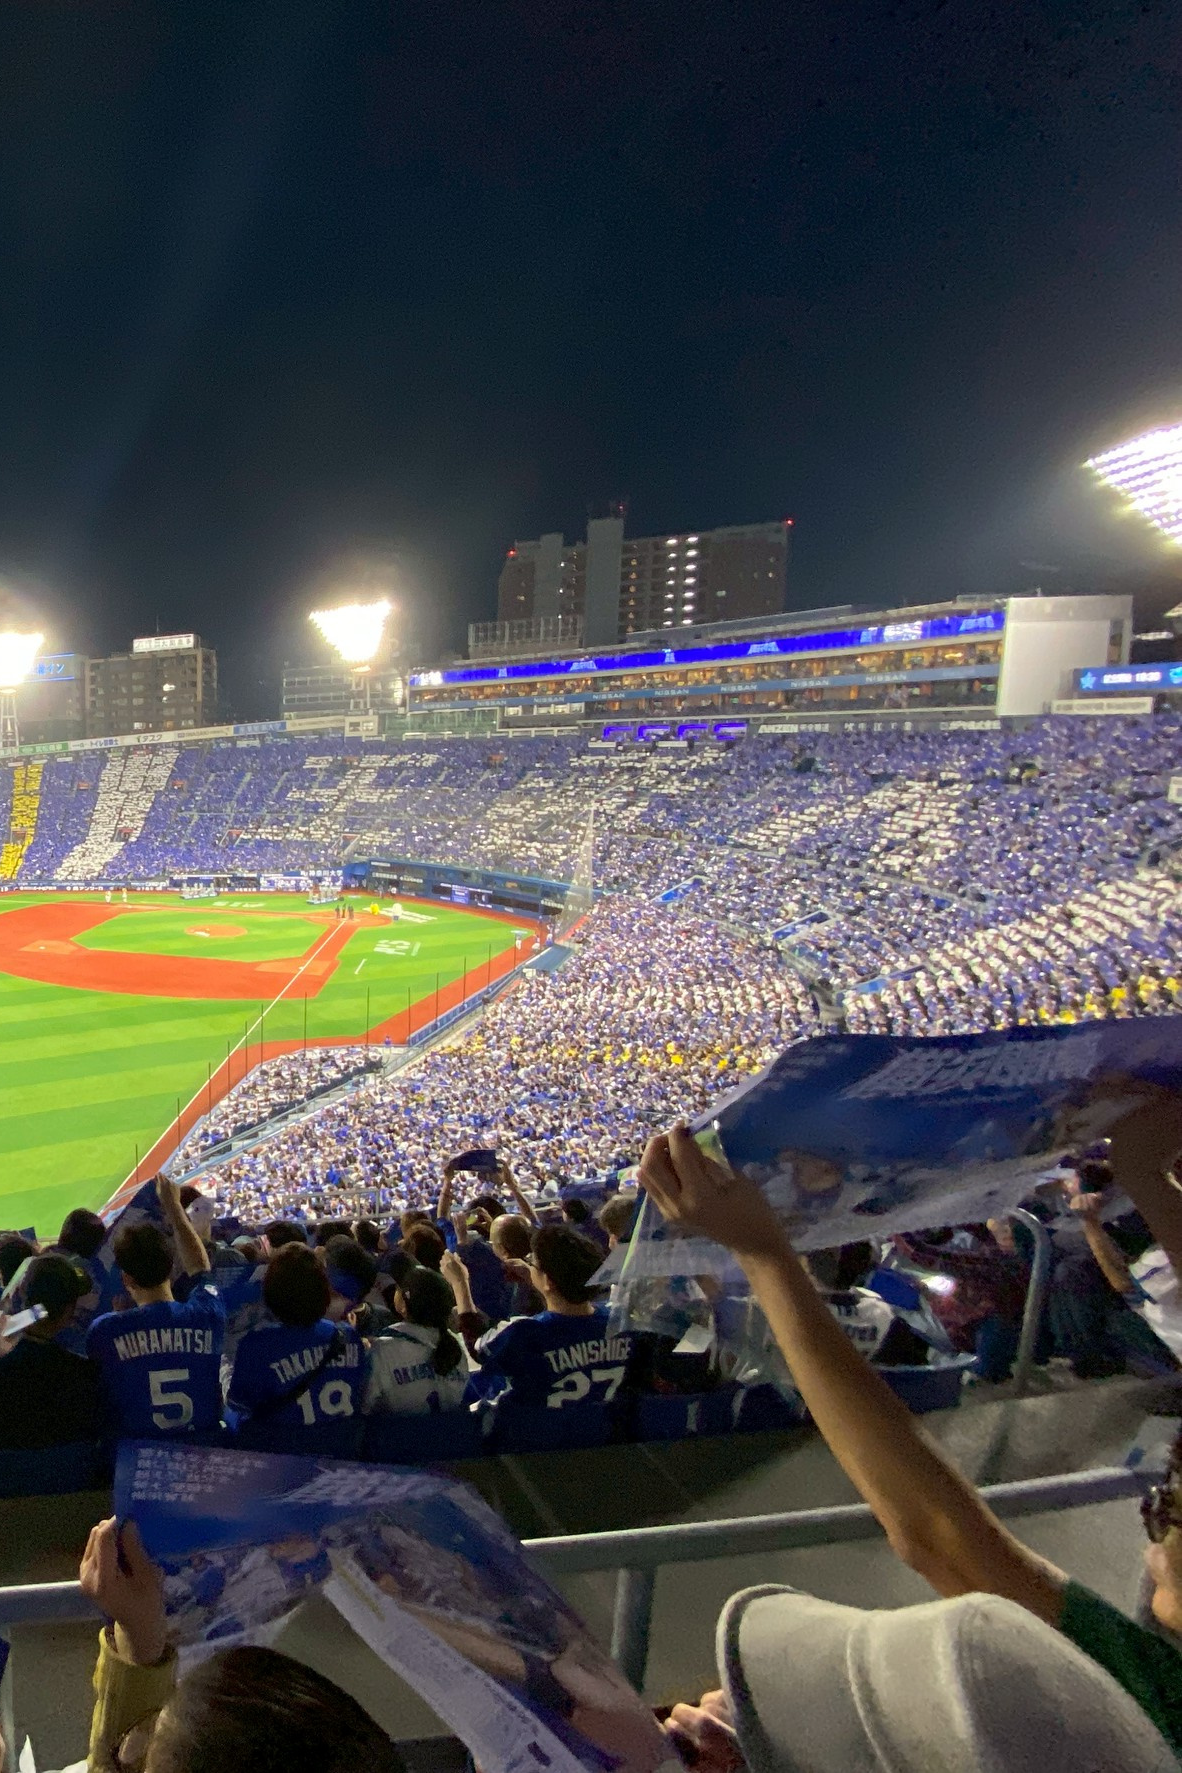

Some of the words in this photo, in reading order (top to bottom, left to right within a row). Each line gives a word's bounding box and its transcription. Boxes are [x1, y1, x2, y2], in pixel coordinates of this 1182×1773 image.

[720, 684, 758, 692] NISSAN
[790, 680, 830, 688] NISSAN
[865, 674, 907, 682] NISSAN
[113, 1327, 213, 1361] MURAMATSU
[543, 1337, 633, 1374] TANISHIGE
[148, 1368, 194, 1430] 5
[296, 1379, 355, 1426] 19
[547, 1366, 626, 1409] 27
